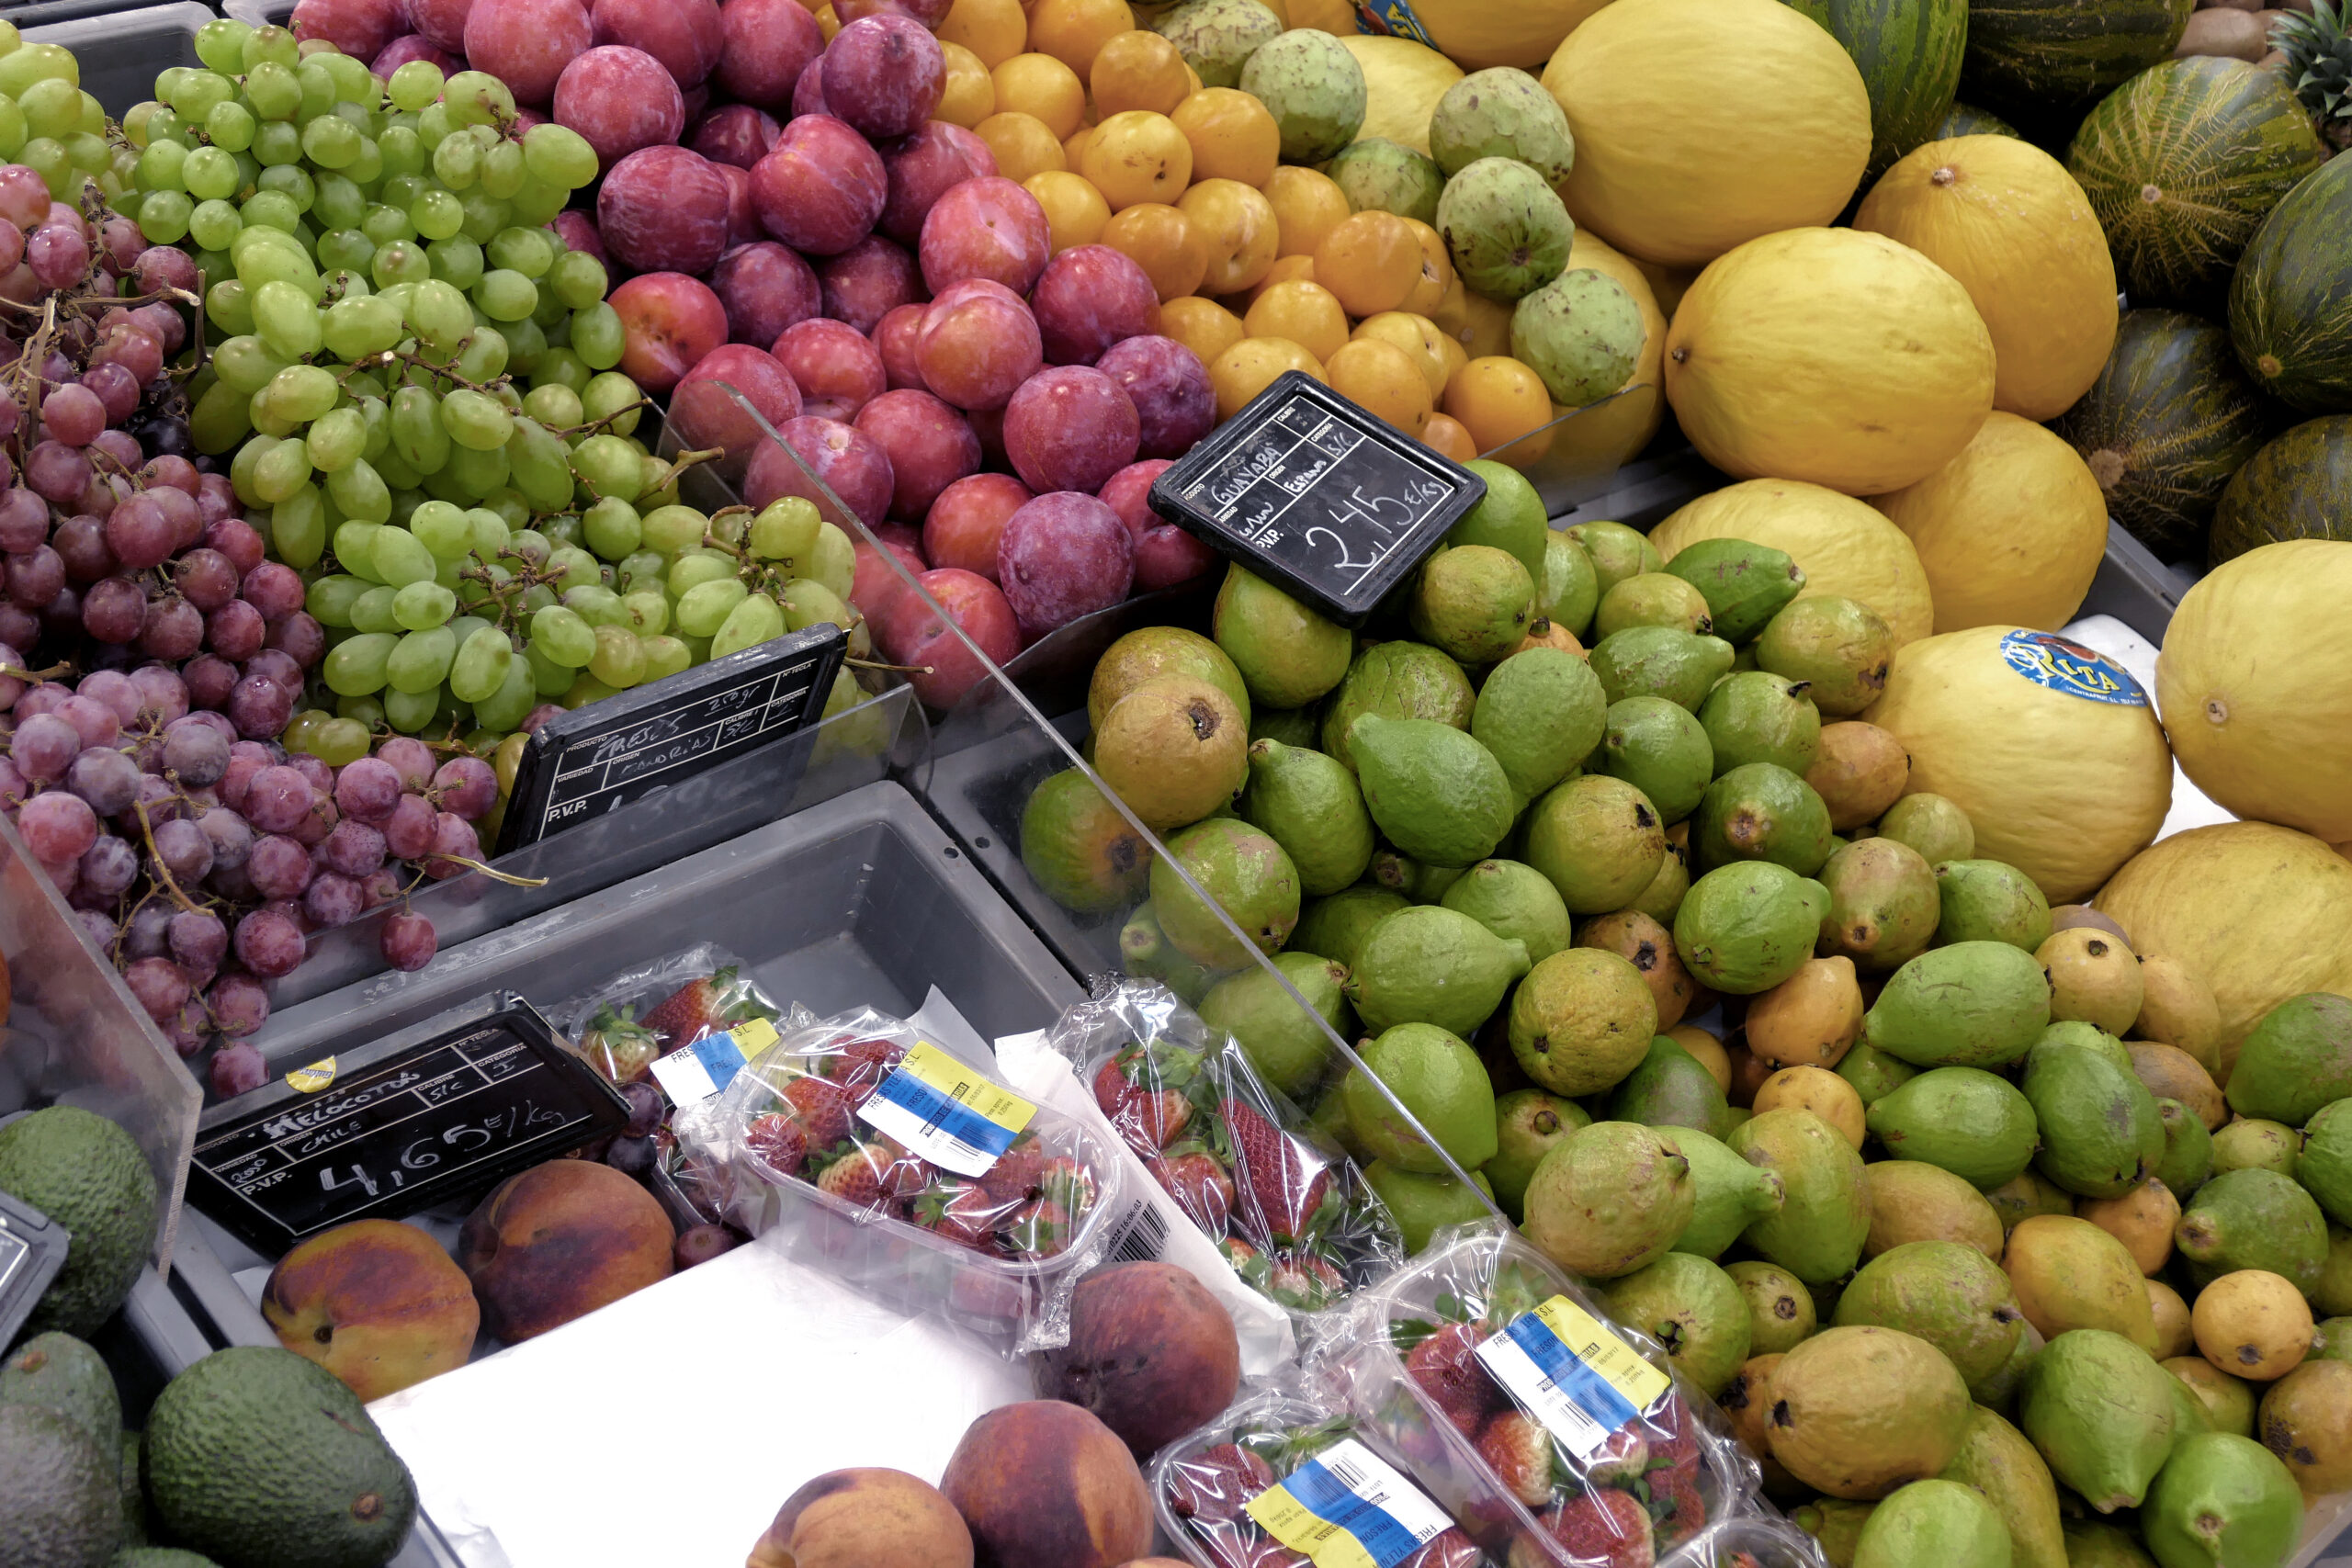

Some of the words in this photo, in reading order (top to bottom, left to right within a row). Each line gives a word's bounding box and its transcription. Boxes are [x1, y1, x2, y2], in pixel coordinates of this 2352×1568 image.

[1211, 446, 1283, 506] GUAYABA
[1268, 465, 1286, 479] ORIGEN
[1218, 506, 1238, 524] ARIEDAD
[792, 663, 812, 674] TECLA
[2006, 644, 2120, 694] RITA
[725, 711, 753, 725] CALIBRE
[566, 736, 608, 752] PRODUCTO
[613, 752, 640, 764] ORIGEN
[558, 767, 594, 783] VARIEDAD
[548, 800, 587, 822] P.V.P.
[469, 1028, 499, 1043] TECLA
[671, 1043, 706, 1063] FRESAS
[735, 1026, 752, 1037] S.L.
[417, 1074, 455, 1091] CALIBRE
[867, 1088, 891, 1110] FRESAS
[906, 1053, 921, 1066] S.L.
[279, 1131, 313, 1147] ORIGEN
[215, 1154, 258, 1173] VARIEDAD
[242, 1171, 293, 1196] P.V.P.
[1121, 1199, 1142, 1232] 16:06:03
[1492, 1326, 1521, 1348] FRESAS
[1539, 1303, 1556, 1318] S.L.
[1356, 1518, 1393, 1544] FRESON
[1401, 1524, 1438, 1550] FRESAS
